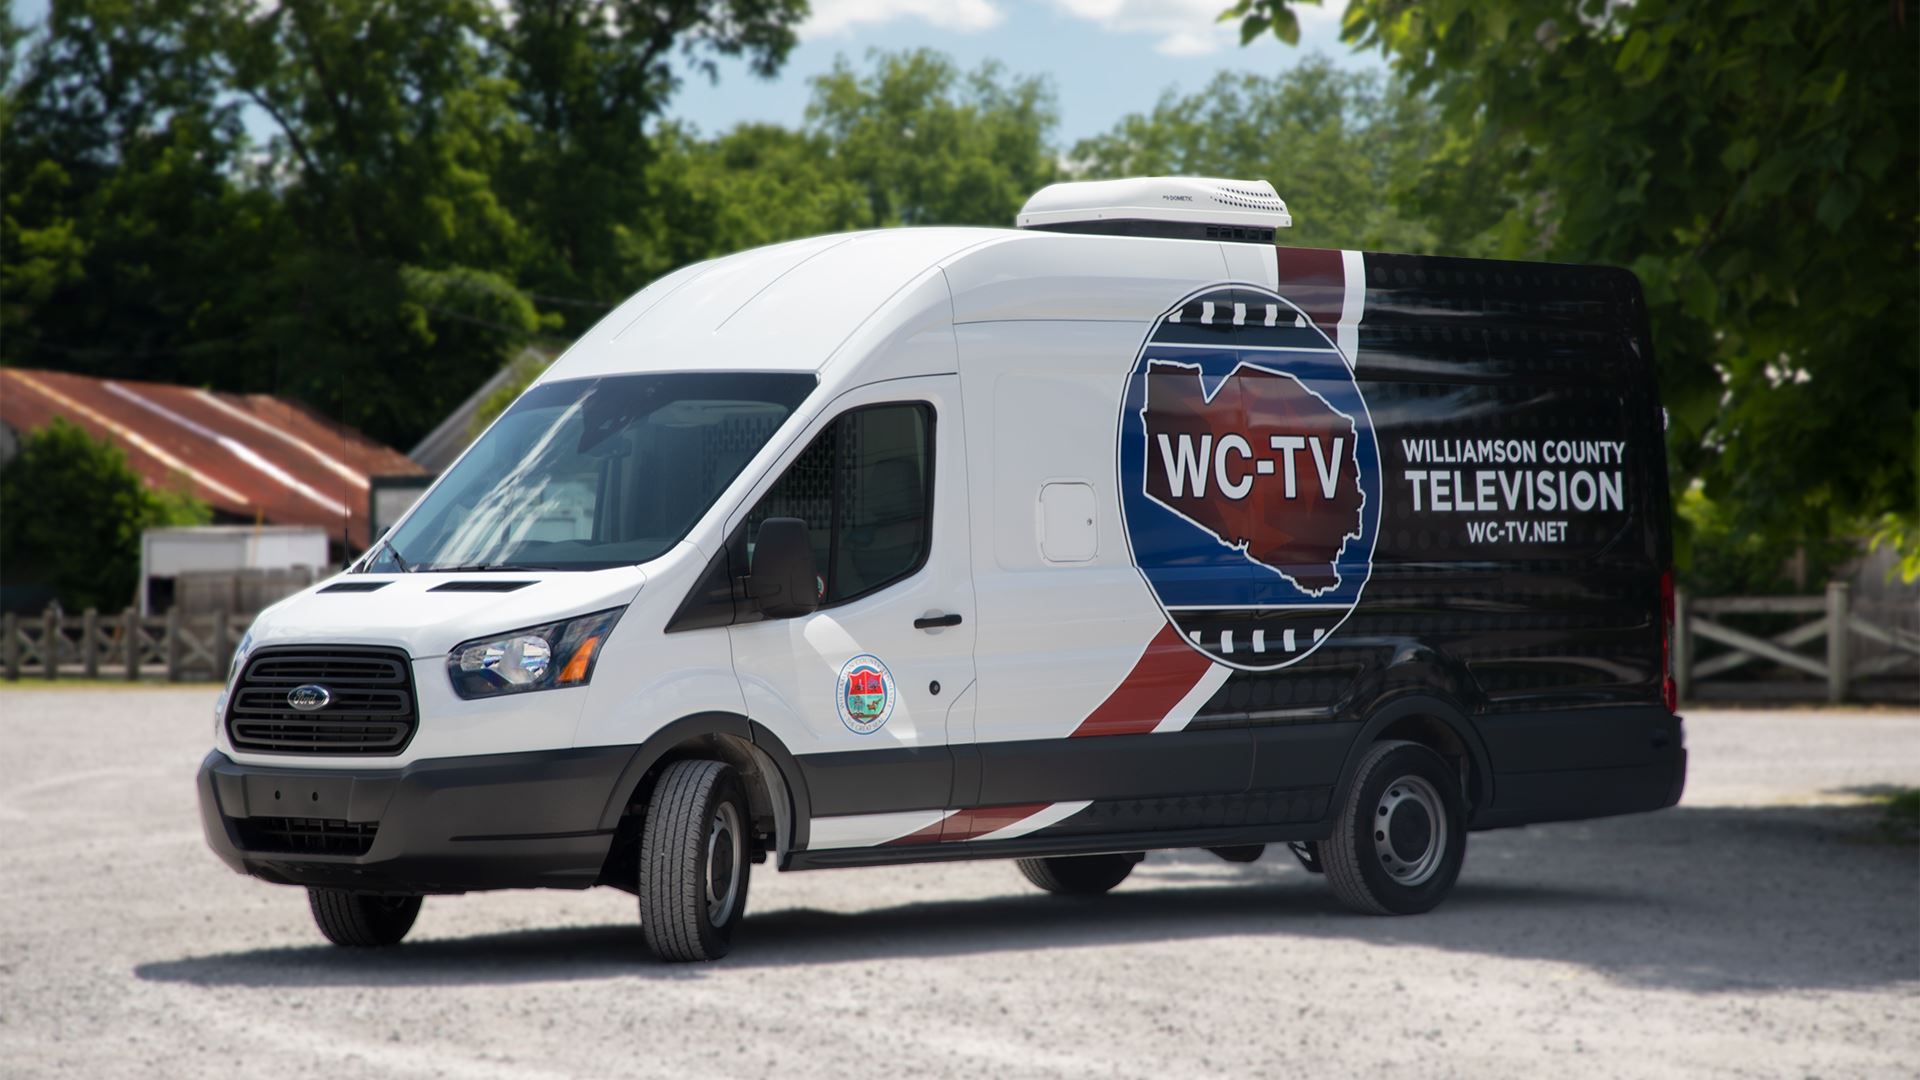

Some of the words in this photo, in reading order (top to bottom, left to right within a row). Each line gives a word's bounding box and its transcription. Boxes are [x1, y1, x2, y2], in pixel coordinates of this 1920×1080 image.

[1402, 439, 1537, 463] WILLIAMSON
[1543, 440, 1625, 464] COUNTY
[1157, 433, 1344, 499] WC-TV
[1405, 470, 1624, 512] TELEVISION
[1467, 521, 1568, 543] WC-TV.NET
[293, 689, 318, 704] Ford
